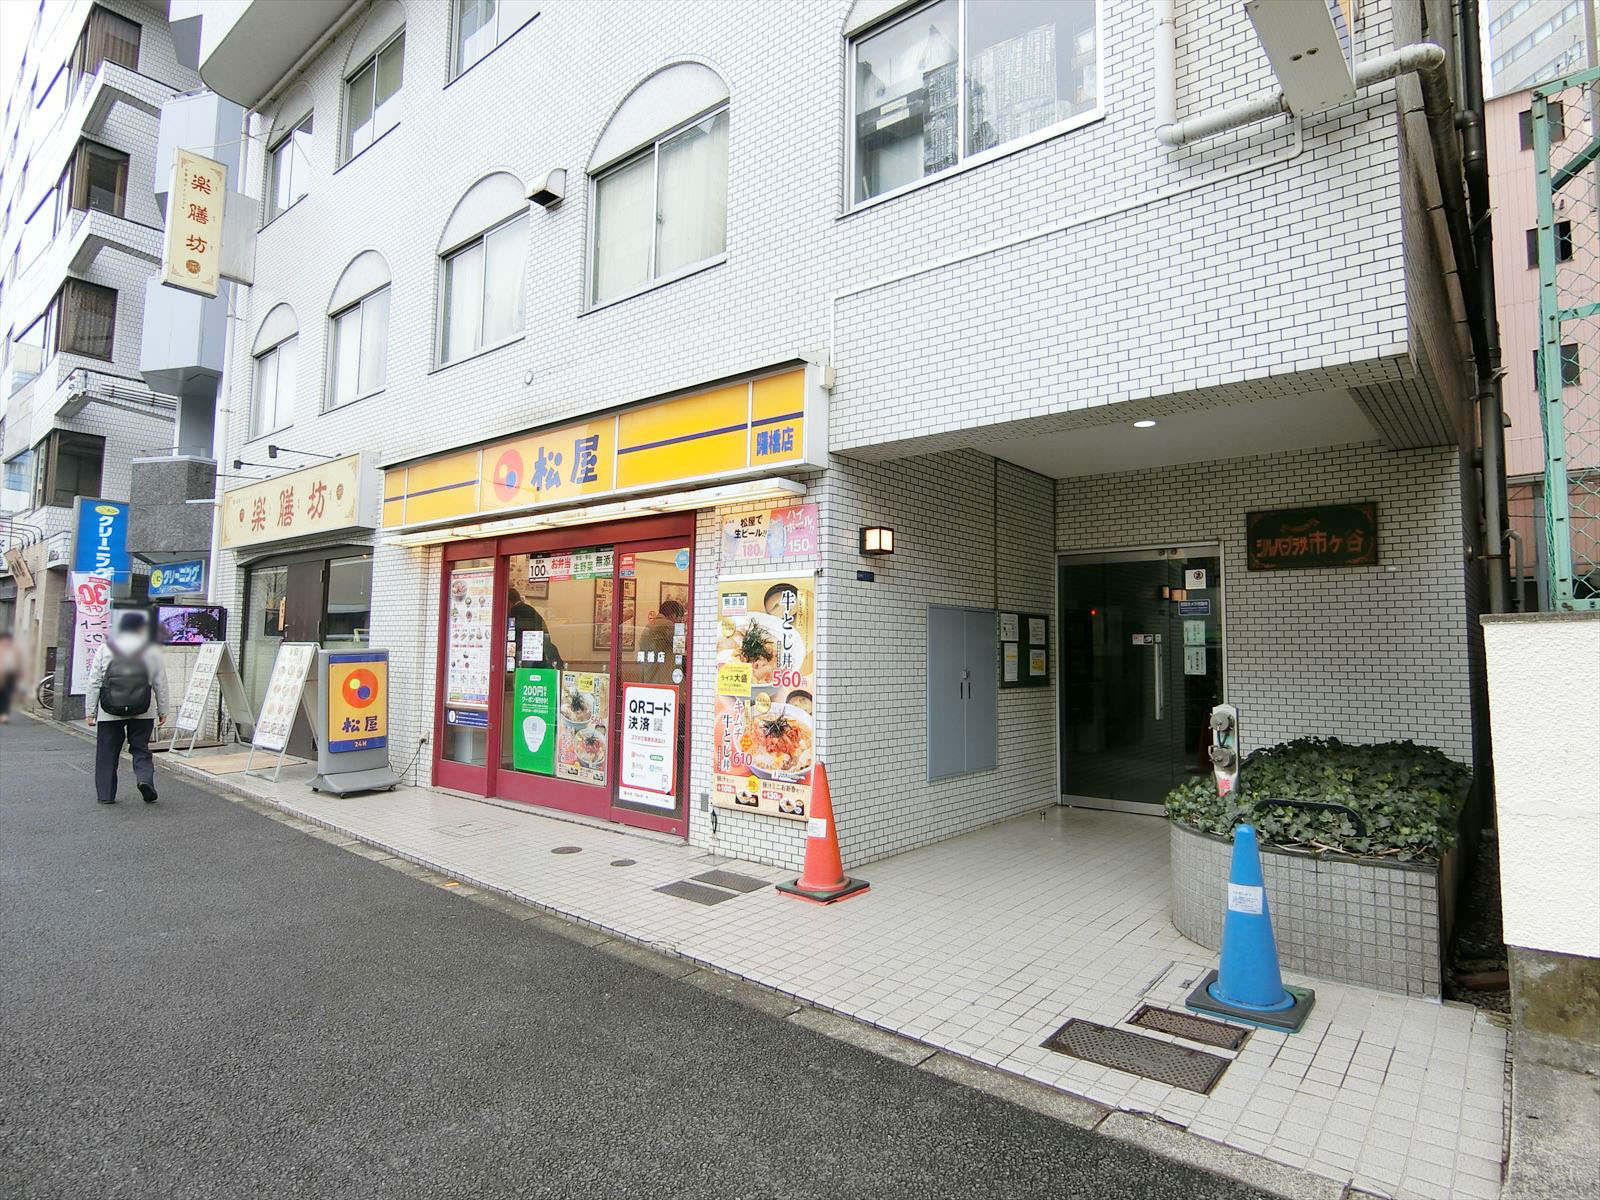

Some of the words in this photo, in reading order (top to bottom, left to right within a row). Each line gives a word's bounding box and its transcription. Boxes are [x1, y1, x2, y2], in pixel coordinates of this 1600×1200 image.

[185, 174, 212, 254] 楽膳坊
[530, 434, 600, 492] 松屋
[251, 480, 328, 532] 楽膳坊
[740, 514, 763, 528] 松屋で
[95, 515, 115, 577] クリーニング
[163, 564, 200, 585] クリーニング
[781, 591, 795, 669] 牛とじ丼
[721, 674, 747, 683] ライス大盛
[629, 699, 672, 716] QRコード
[342, 715, 378, 733] 松屋
[628, 716, 650, 732] 決済
[734, 700, 744, 741] キムチ
[354, 740, 368, 748] 24H
[723, 714, 733, 771] 牛とじ丼
[733, 752, 753, 766] 610
